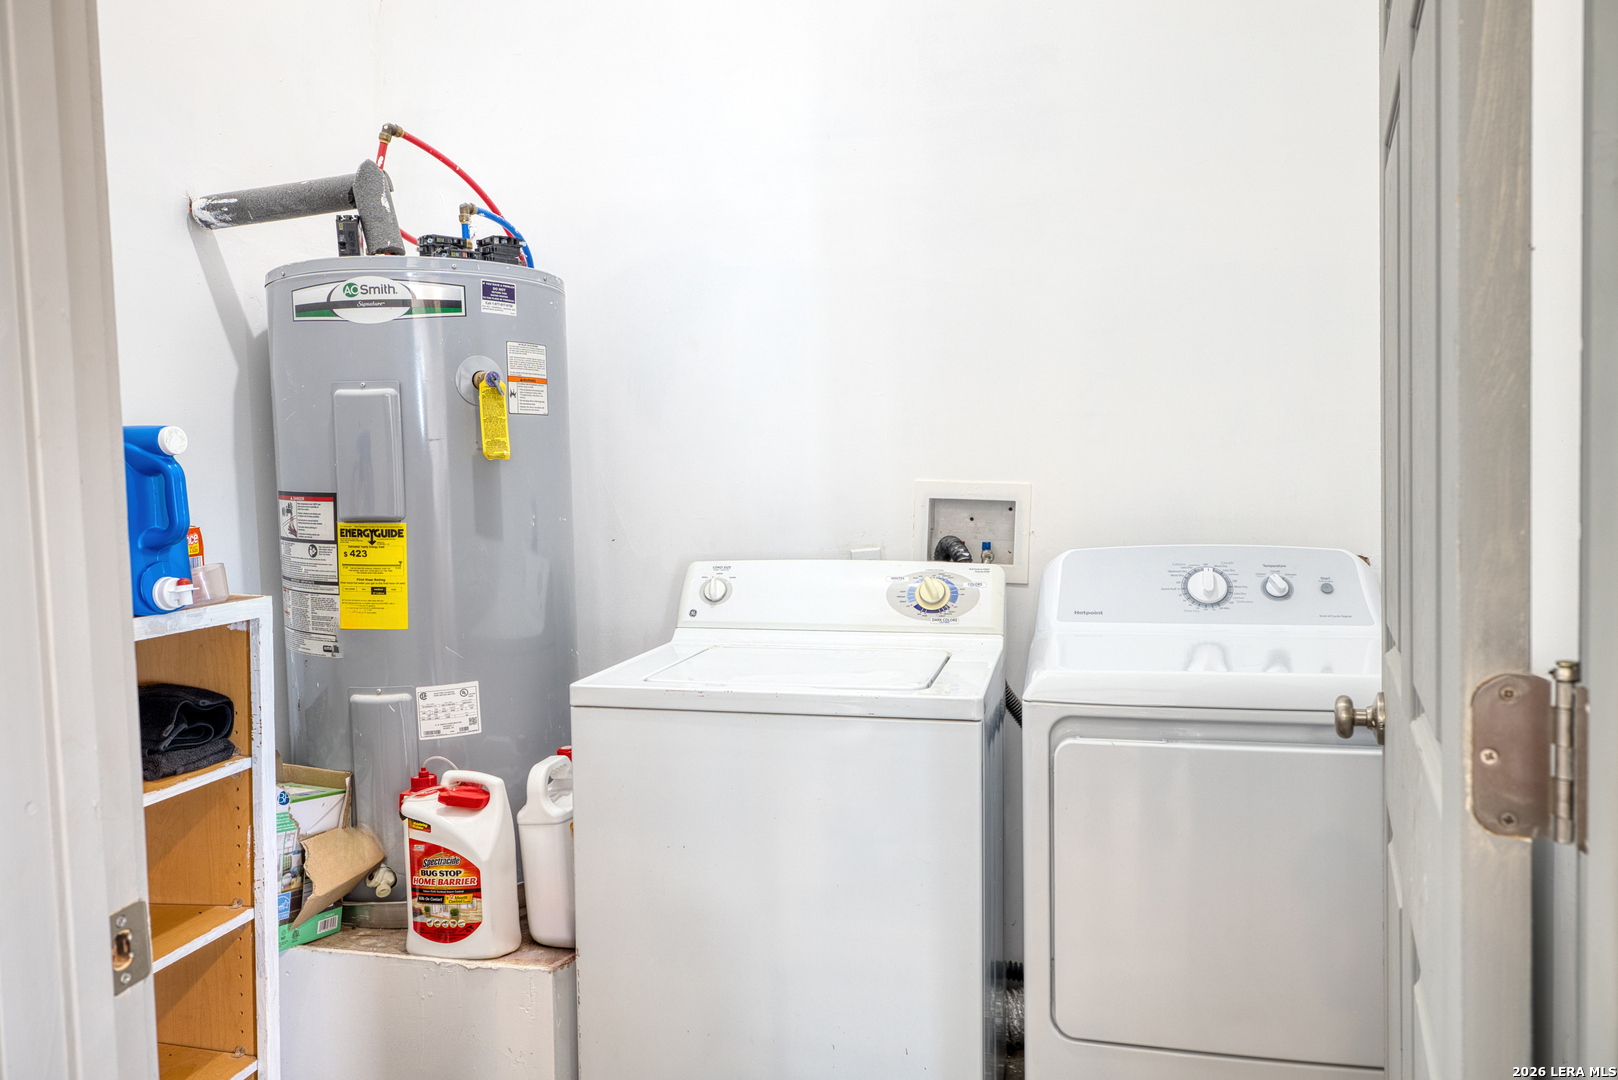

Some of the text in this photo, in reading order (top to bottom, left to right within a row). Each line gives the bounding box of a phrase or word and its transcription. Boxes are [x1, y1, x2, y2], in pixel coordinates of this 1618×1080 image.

[340, 528, 404, 538] ENERGYGUIDE
[422, 856, 462, 868] Spectracide
[413, 877, 477, 886] HOME BARRIER
